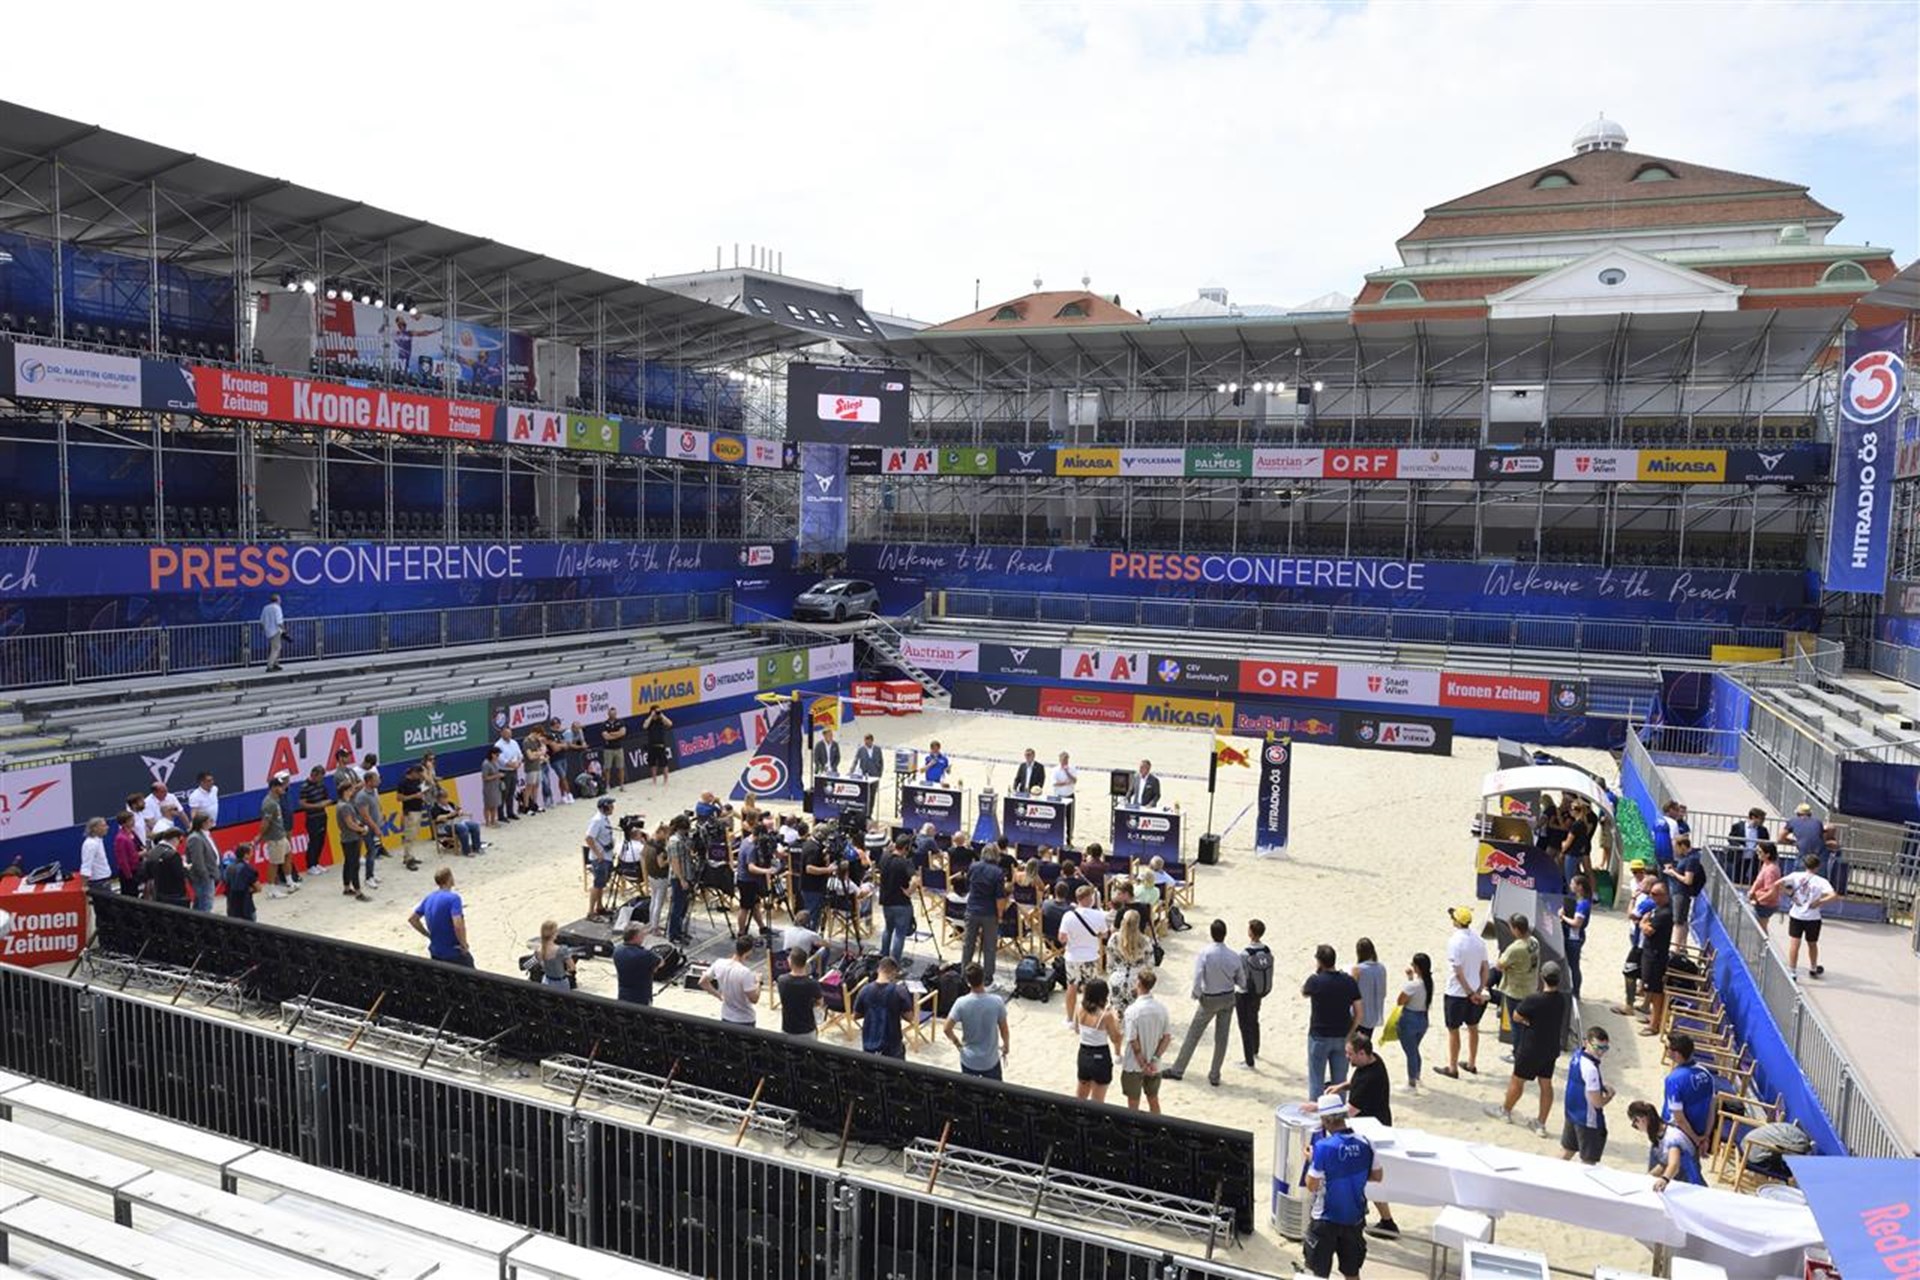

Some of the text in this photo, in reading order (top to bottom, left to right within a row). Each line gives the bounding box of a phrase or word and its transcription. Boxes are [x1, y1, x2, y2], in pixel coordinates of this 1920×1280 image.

[64, 367, 100, 379] MARTIN
[101, 371, 137, 383] GRUBER
[222, 372, 268, 395] Kronen
[222, 393, 269, 416] Zeitung
[293, 381, 371, 426] Krone
[835, 398, 863, 414] Stiegl
[514, 411, 562, 442] A1 A1
[887, 450, 907, 471] A1
[913, 450, 933, 471] A1
[1137, 457, 1182, 465] VOLKSBANK
[1194, 459, 1242, 468] PALMERS
[1256, 456, 1301, 467] Austrian
[1332, 455, 1388, 472] ORF
[1593, 457, 1617, 466] Stadt
[1593, 465, 1617, 474] Wien
[1851, 431, 1878, 569] HITRADIO Ö3
[556, 542, 622, 577] Welcome
[626, 545, 640, 571] to
[640, 544, 659, 571] the
[877, 544, 947, 571] Welcome
[955, 548, 969, 570] to
[972, 548, 996, 572] the
[1483, 564, 1585, 597] Welcome
[1596, 568, 1617, 597] to
[1620, 569, 1655, 598] the
[903, 644, 954, 660] Austrian
[1073, 651, 1137, 681] A1 A1
[1257, 668, 1320, 690] ORF
[1384, 675, 1409, 687] Stadt
[590, 691, 609, 702] Stadt
[1384, 685, 1409, 695] Wien
[1447, 681, 1541, 704] Kronen Zeitung
[511, 706, 525, 726] A1
[590, 703, 609, 713] Wien
[404, 720, 468, 745] PALMERS
[1381, 725, 1400, 742] A1
[267, 719, 363, 783] A1 A1
[1268, 785, 1280, 832] HITRADIO
[4, 933, 78, 954] Zeitung
